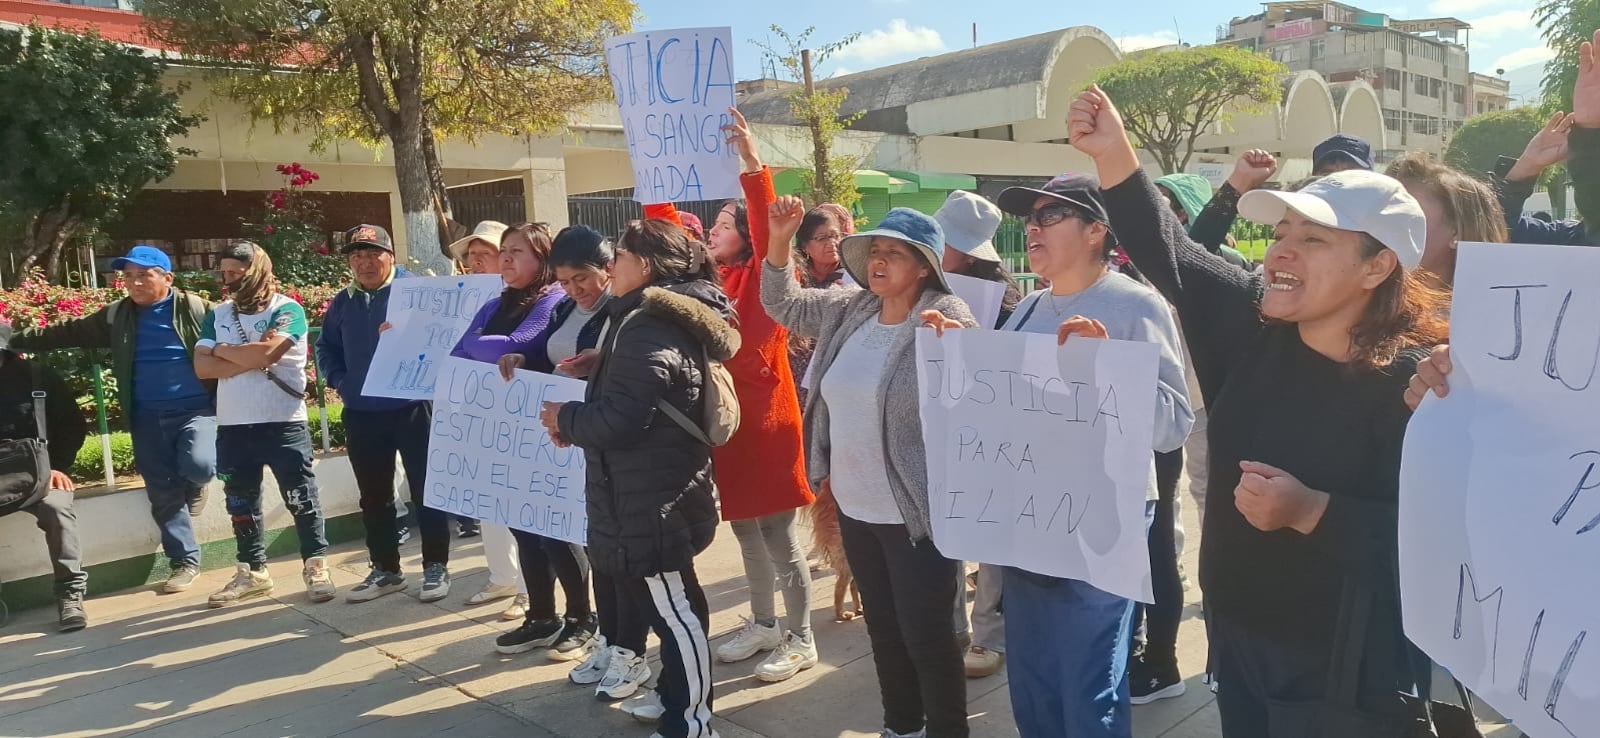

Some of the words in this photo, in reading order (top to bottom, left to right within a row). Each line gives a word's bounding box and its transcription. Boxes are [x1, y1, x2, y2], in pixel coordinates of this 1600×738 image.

[401, 282, 497, 321] JUSTICI
[448, 366, 497, 410] LOS
[926, 358, 1123, 435] JUSTICIA
[429, 448, 480, 481] CON
[491, 463, 519, 491] EL
[529, 470, 569, 500] ESE
[953, 425, 1037, 474] PARA
[430, 482, 510, 526] SABEN
[934, 484, 1092, 535] ILAN
